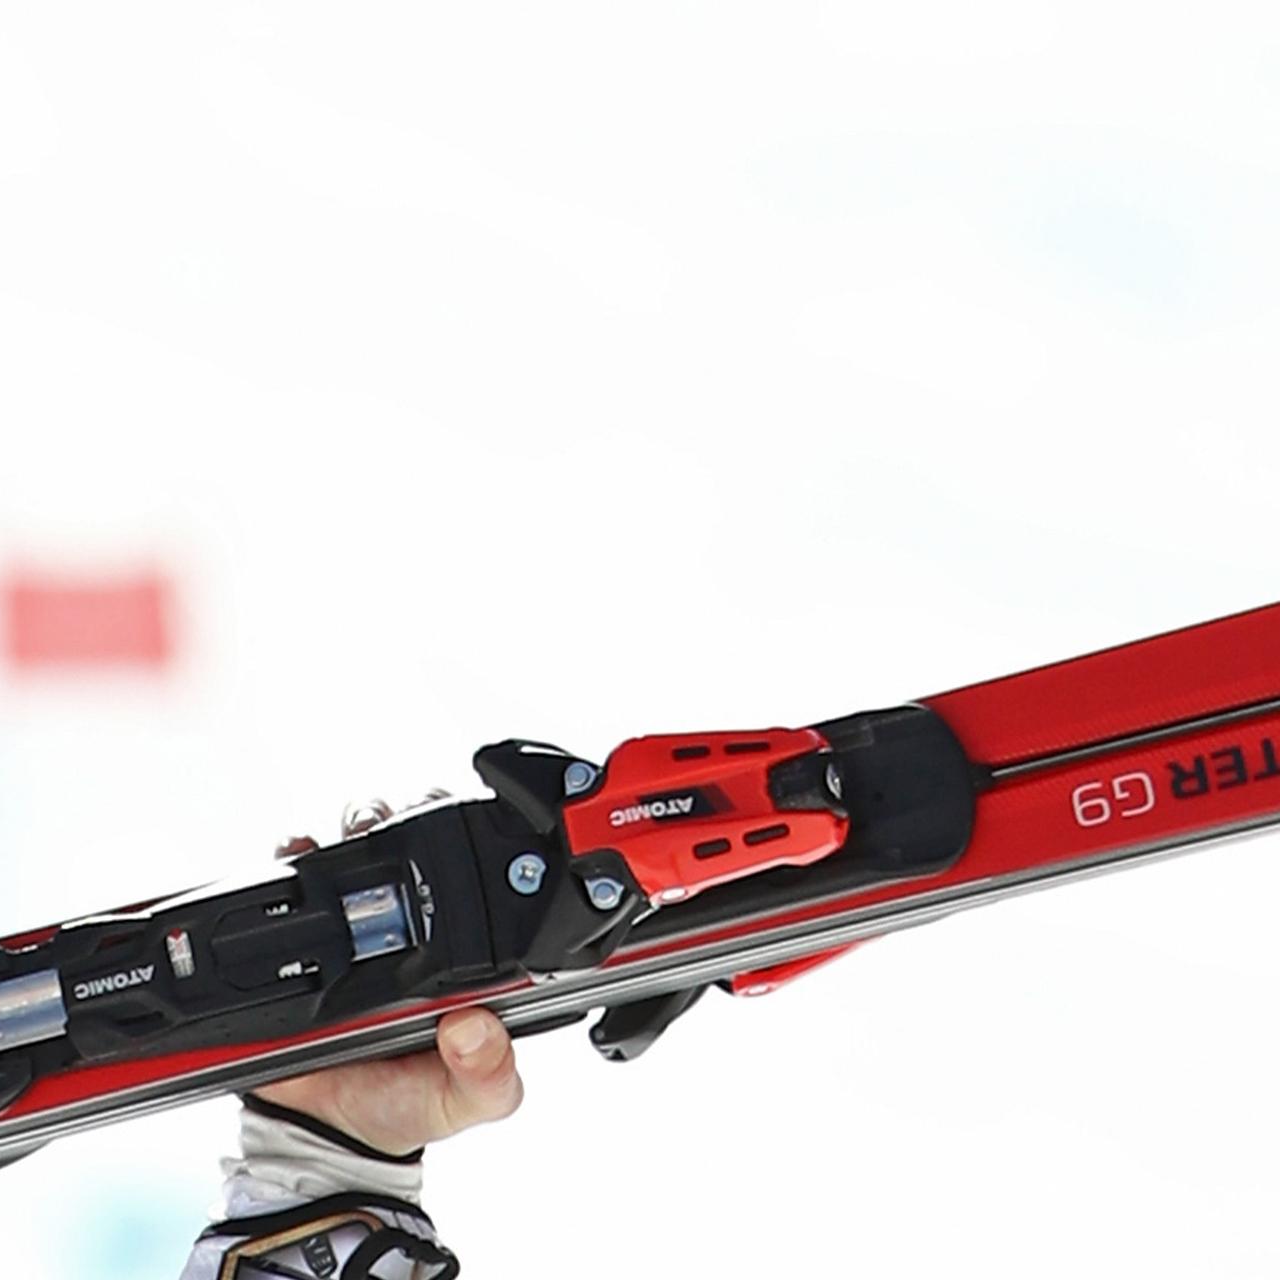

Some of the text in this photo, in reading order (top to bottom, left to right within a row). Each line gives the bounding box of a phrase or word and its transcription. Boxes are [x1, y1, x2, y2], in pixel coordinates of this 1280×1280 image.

[609, 795, 694, 827] ATOMIC
[1071, 771, 1156, 828] G9
[73, 964, 155, 1000] ATOMIC
